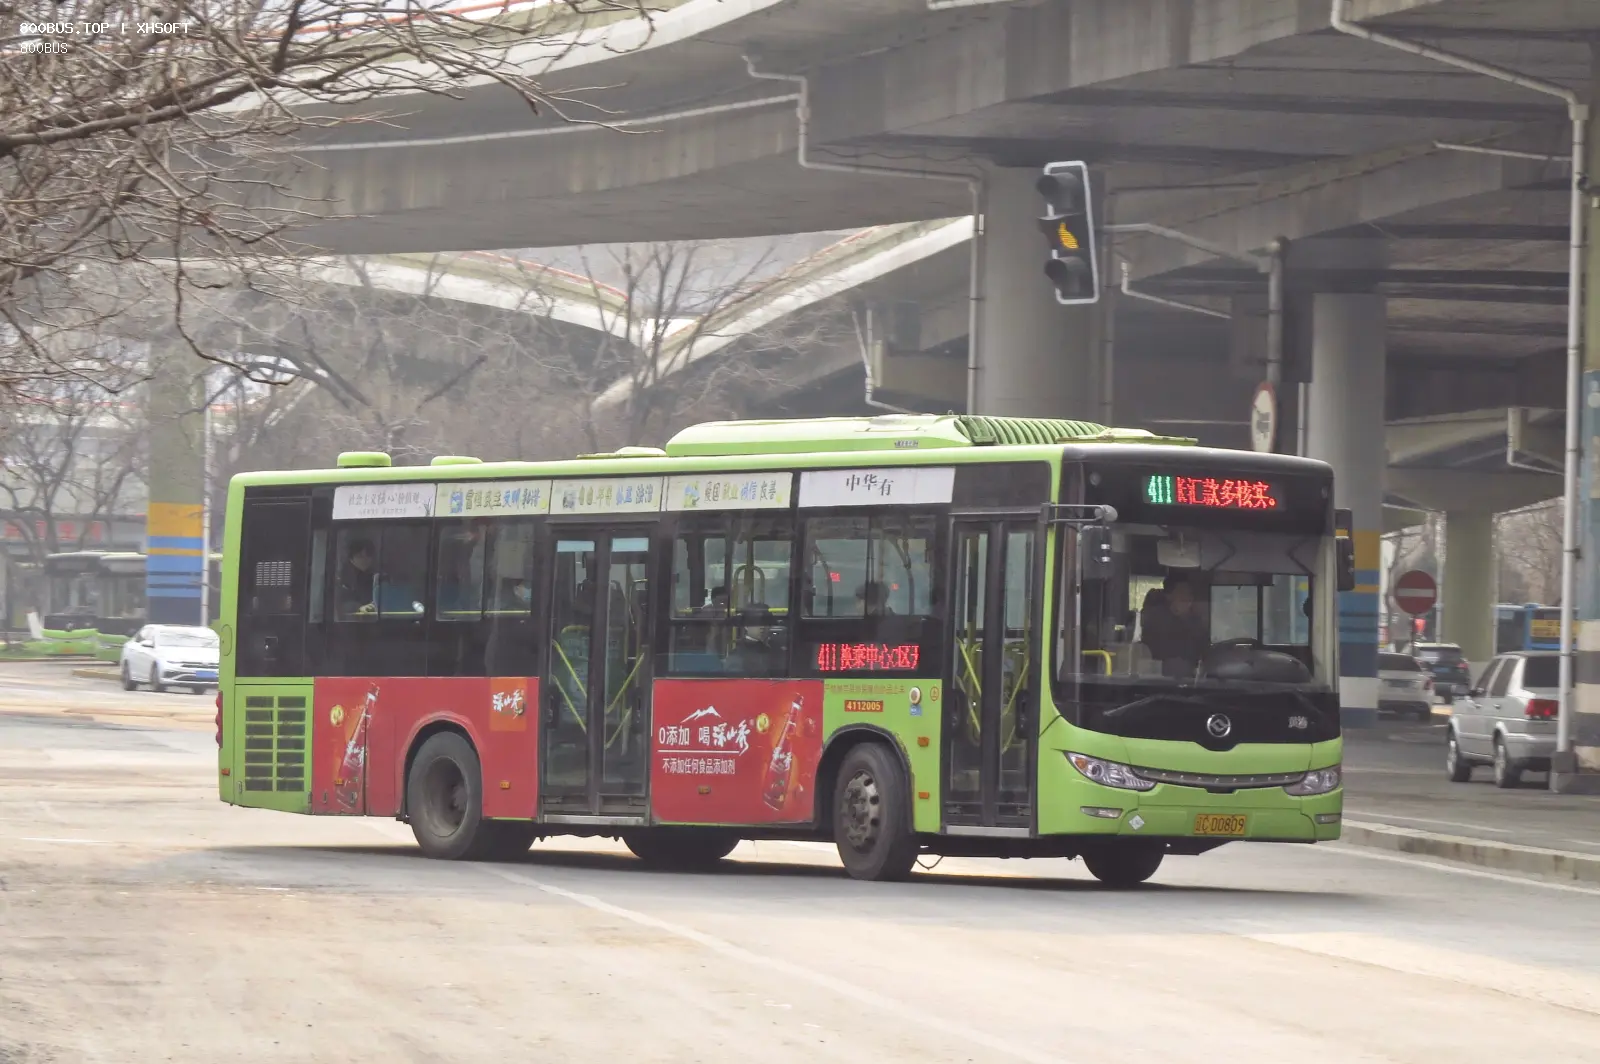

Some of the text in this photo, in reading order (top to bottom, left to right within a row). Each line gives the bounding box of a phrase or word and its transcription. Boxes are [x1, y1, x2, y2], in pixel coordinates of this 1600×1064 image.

[846, 473, 894, 496] 中华有
[1148, 475, 1171, 504] 411
[818, 643, 837, 671] 411
[846, 701, 881, 711] 4112005
[658, 725, 690, 746] 0添加
[662, 757, 736, 776] 不添加任何食品添加剂
